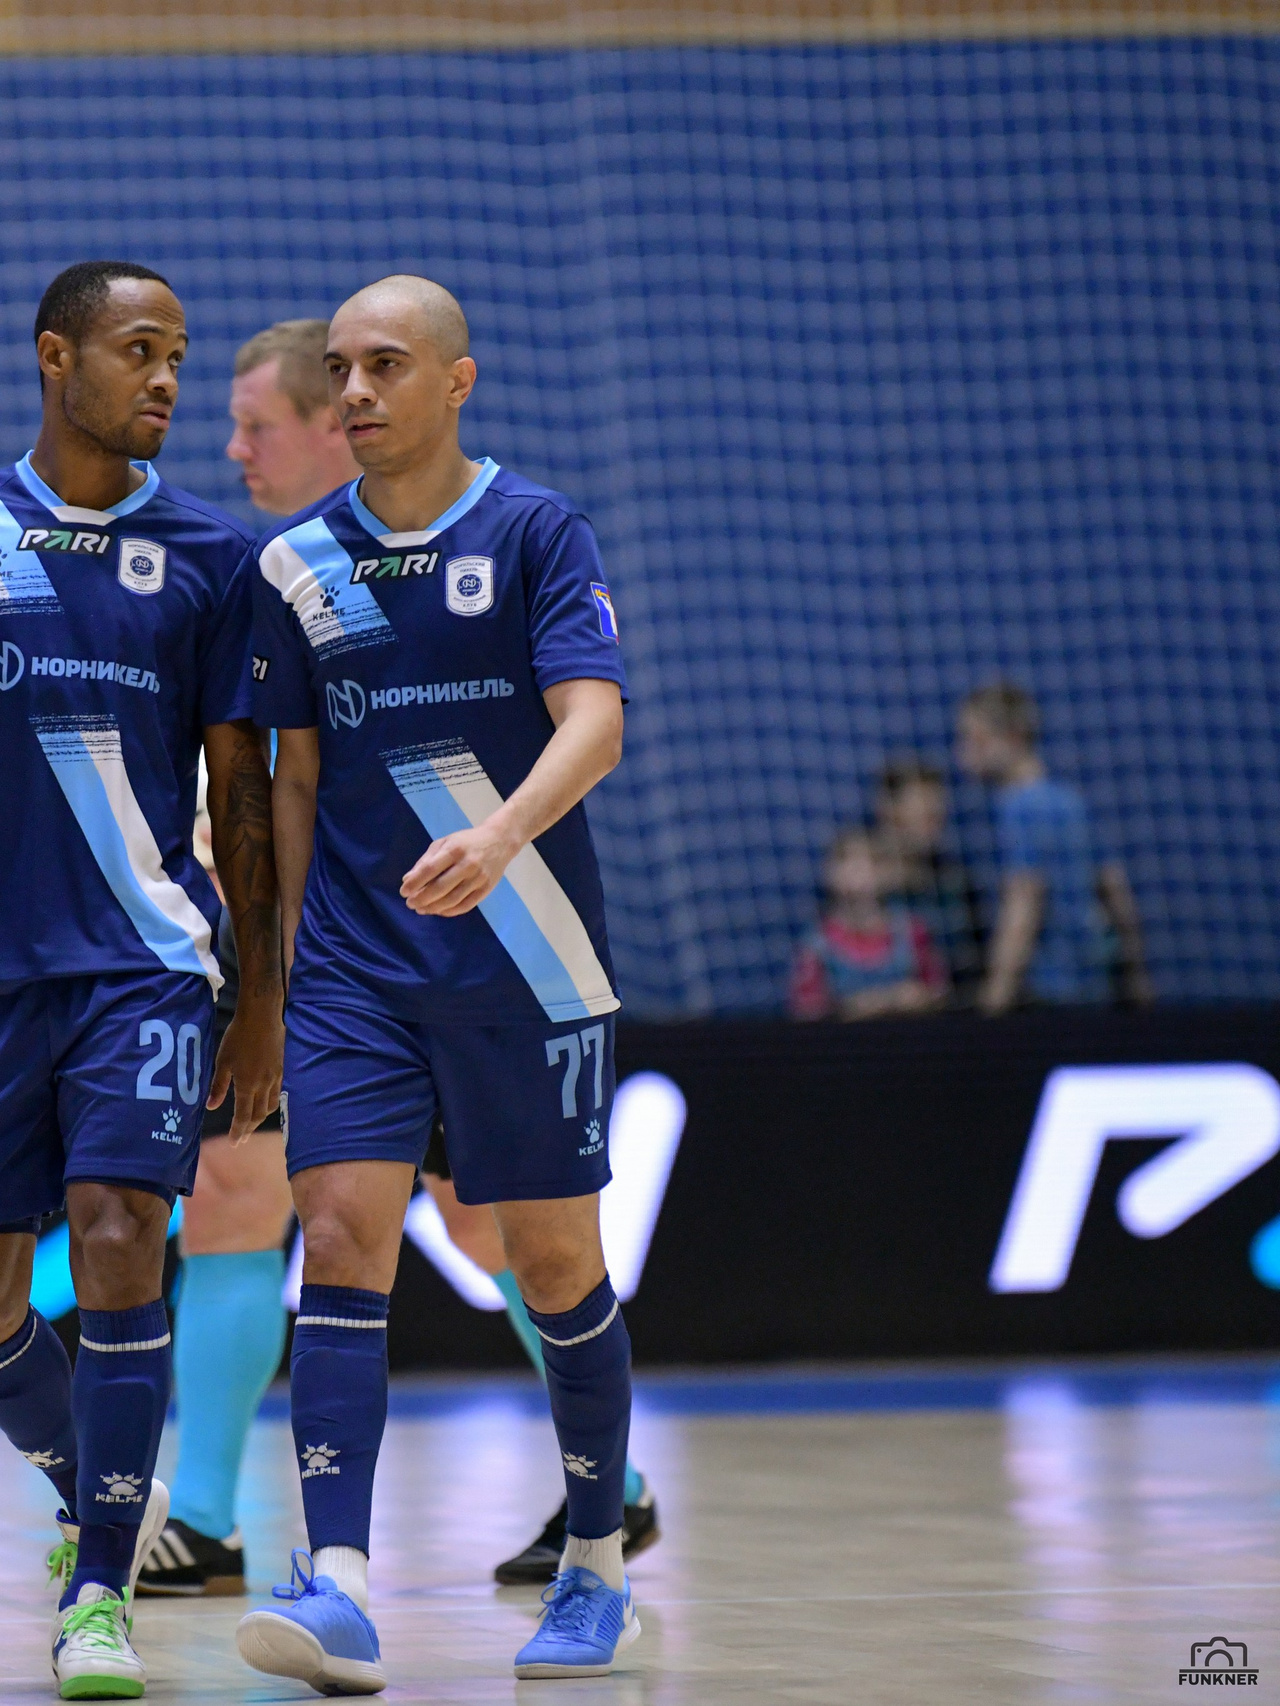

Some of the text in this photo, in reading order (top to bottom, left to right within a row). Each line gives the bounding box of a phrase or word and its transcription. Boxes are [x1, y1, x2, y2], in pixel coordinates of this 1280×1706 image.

[19, 529, 110, 554] PARI
[352, 552, 439, 583] PARI
[312, 607, 346, 621] KELME
[31, 656, 161, 694] НОРНИКЕЛЬ
[370, 678, 516, 711] НОРНИКЕЛЬ
[136, 1018, 202, 1106] 20
[545, 1022, 605, 1119] 77
[151, 1130, 183, 1145] KELME
[95, 1492, 144, 1503] KELME
